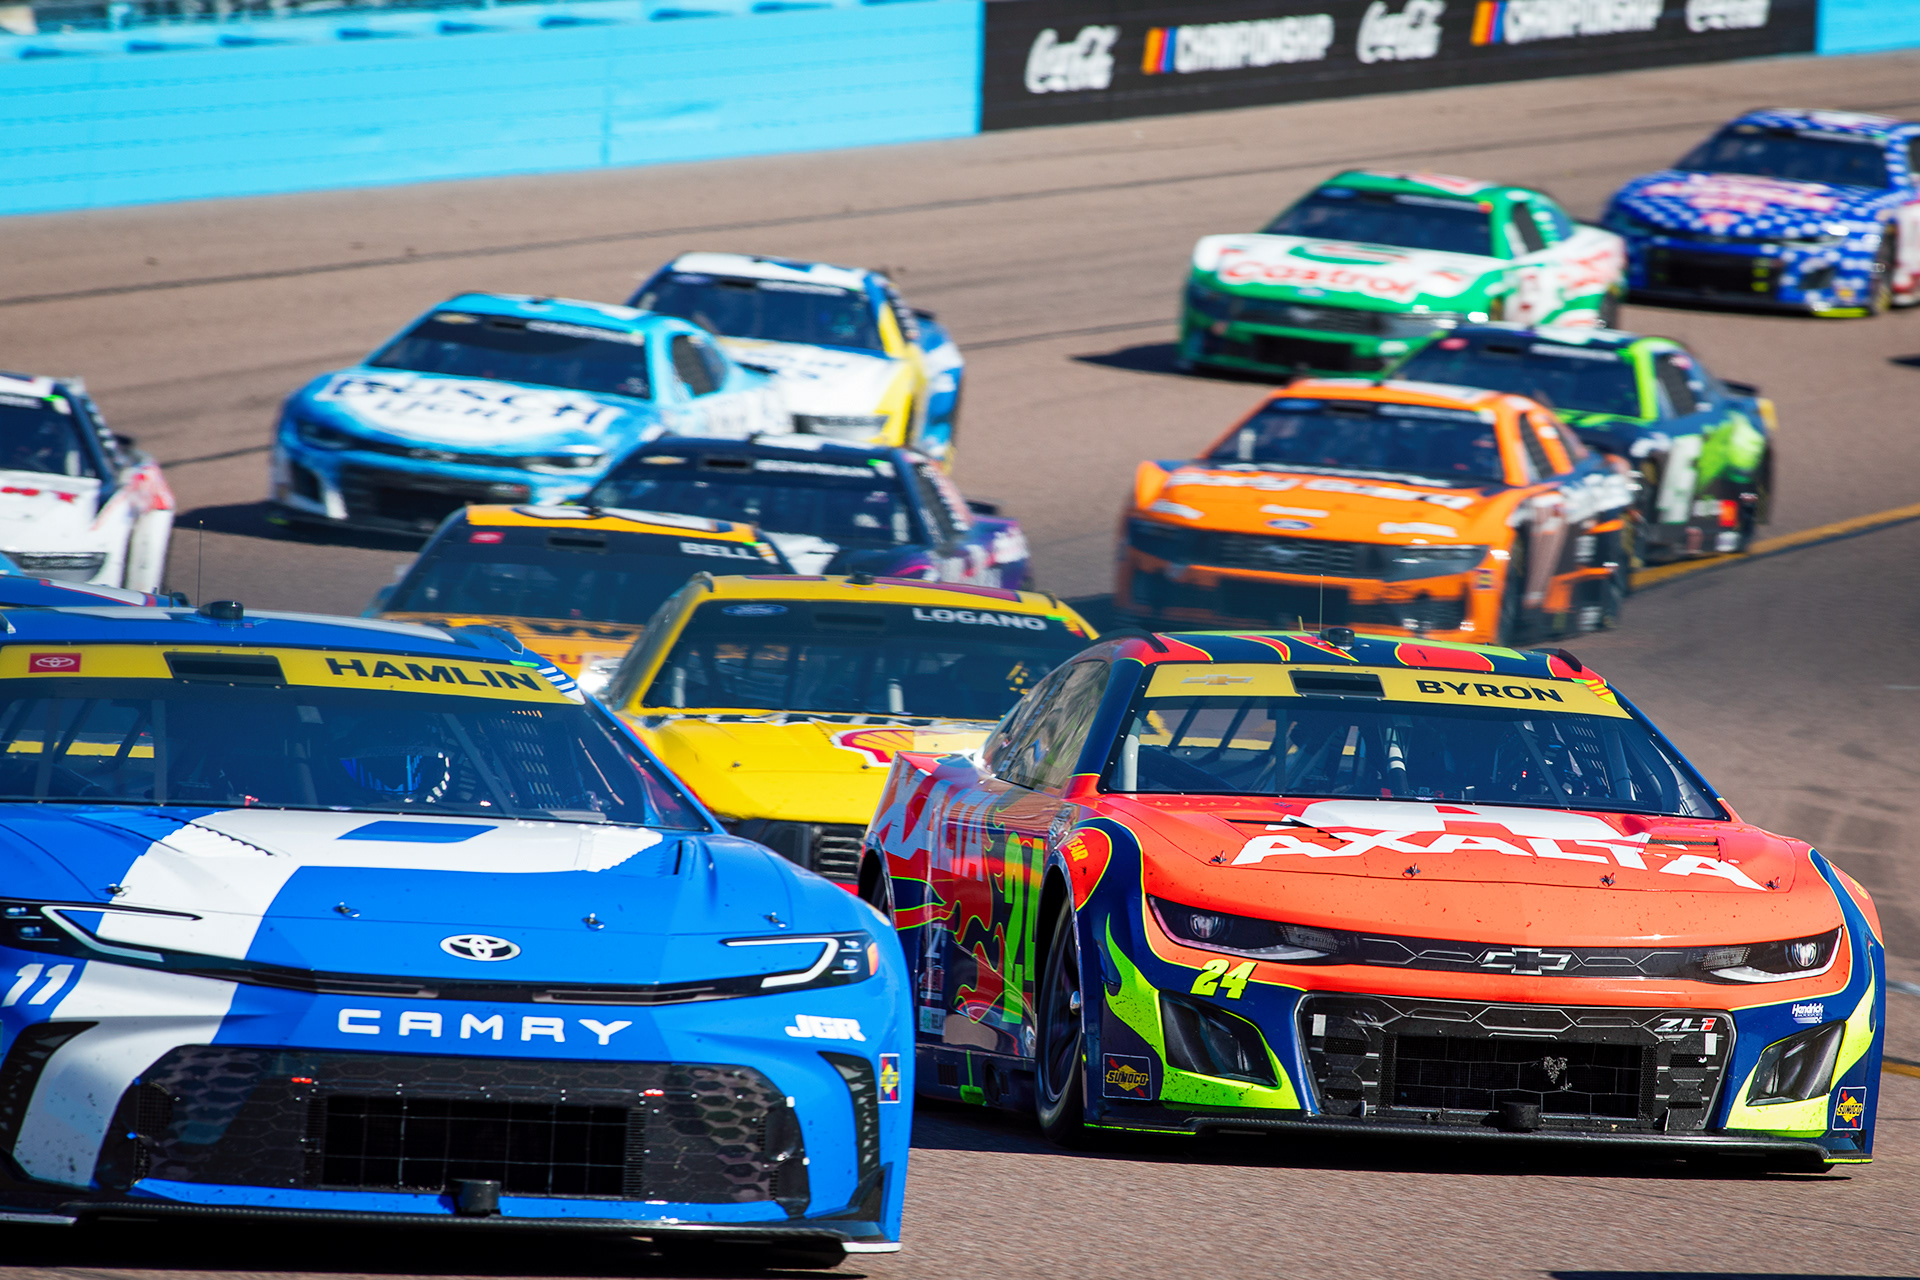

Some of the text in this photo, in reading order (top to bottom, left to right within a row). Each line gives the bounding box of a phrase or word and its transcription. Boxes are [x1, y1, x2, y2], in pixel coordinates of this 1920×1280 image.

[679, 541, 760, 561] BELL
[912, 607, 1048, 631] LOGANO
[325, 657, 542, 692] HAMLIN
[1415, 679, 1564, 703] BYRON
[1231, 829, 1768, 891] AXALTA
[0, 963, 75, 1008] 11
[1189, 958, 1258, 1000] 24
[1791, 1002, 1824, 1017] Hendrick
[338, 1008, 633, 1046] CAMRY
[784, 1014, 867, 1042] JGR
[1106, 1070, 1149, 1086] SUNOCO
[1836, 1102, 1864, 1116] SUNOCO
